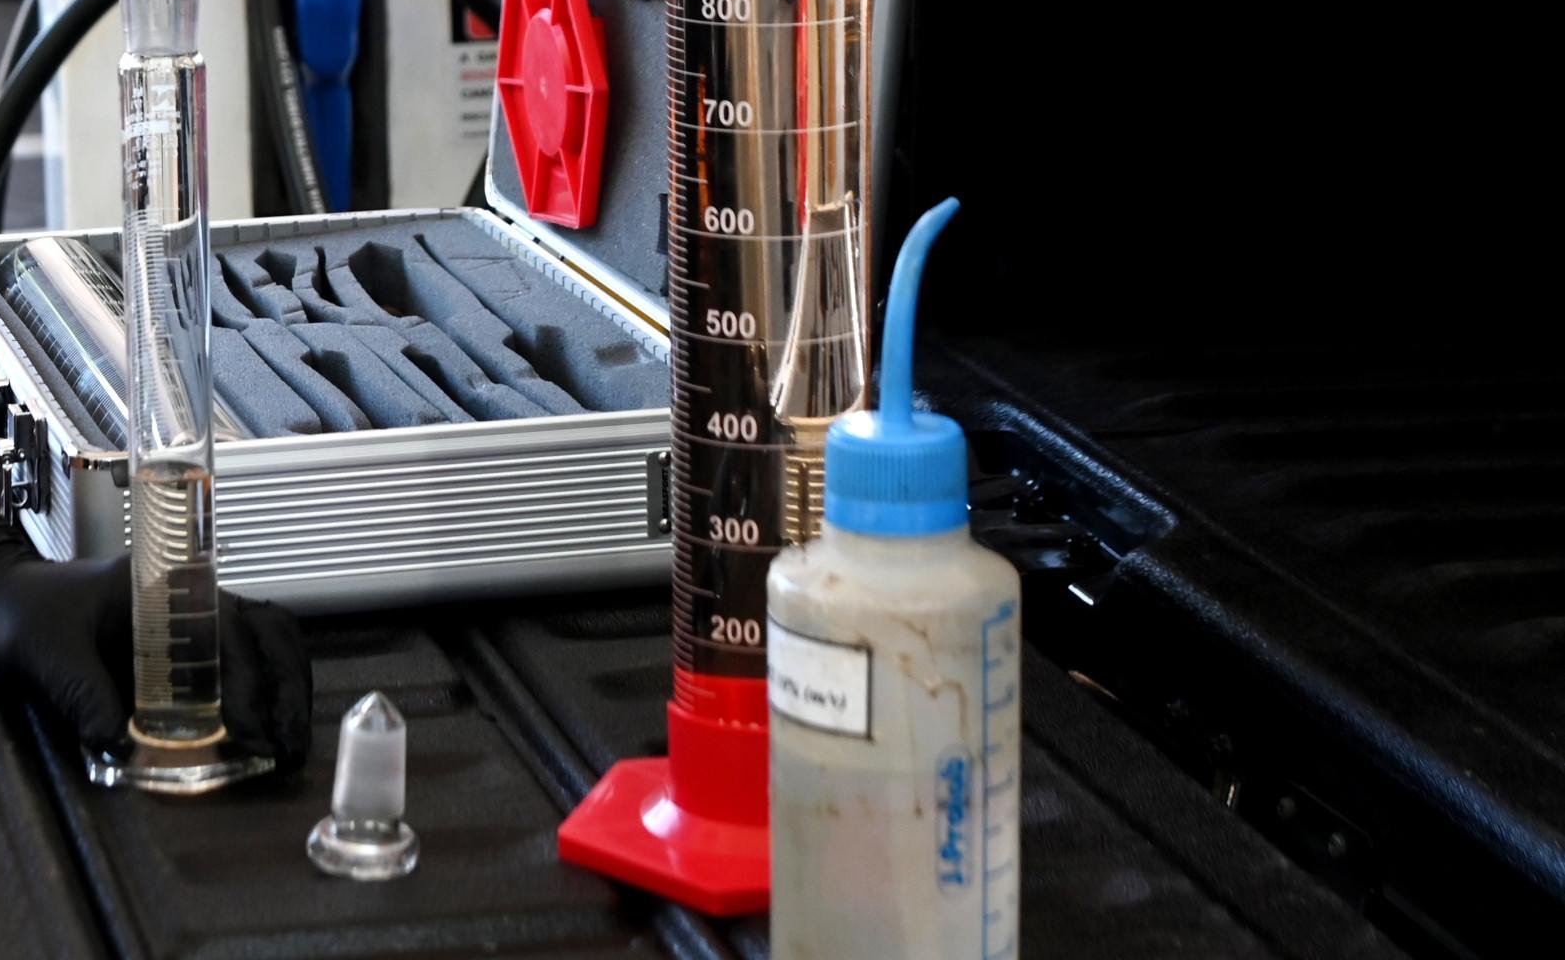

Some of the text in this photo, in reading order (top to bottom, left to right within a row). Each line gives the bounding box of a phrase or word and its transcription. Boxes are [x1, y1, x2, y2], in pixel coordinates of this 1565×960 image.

[703, 98, 754, 127] 700
[704, 206, 755, 235] 600
[706, 309, 756, 339] 500
[707, 412, 757, 441] 400
[709, 515, 759, 544] 300
[710, 614, 760, 644] 200
